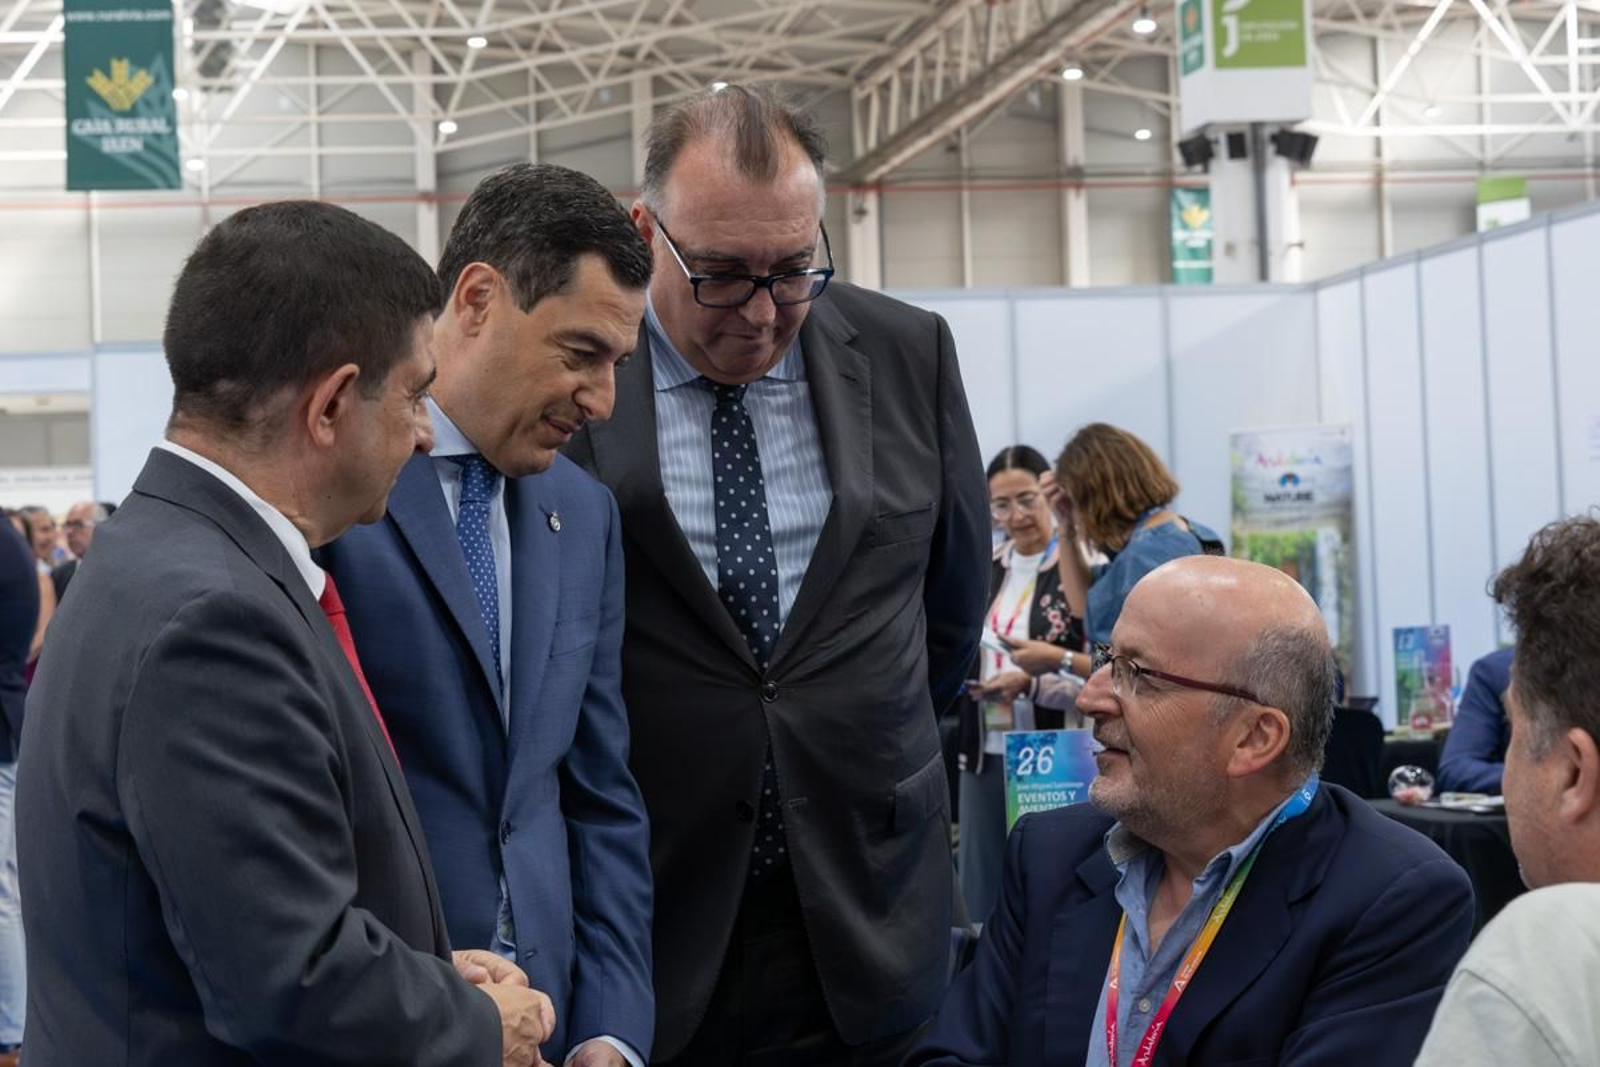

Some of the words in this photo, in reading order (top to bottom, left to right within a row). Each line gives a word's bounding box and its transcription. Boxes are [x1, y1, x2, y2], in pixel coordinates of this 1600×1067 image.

[115, 116, 172, 134] RURAL
[1016, 746, 1055, 775] 26
[1017, 791, 1067, 803] EVENTOS
[1068, 790, 1076, 801] Y
